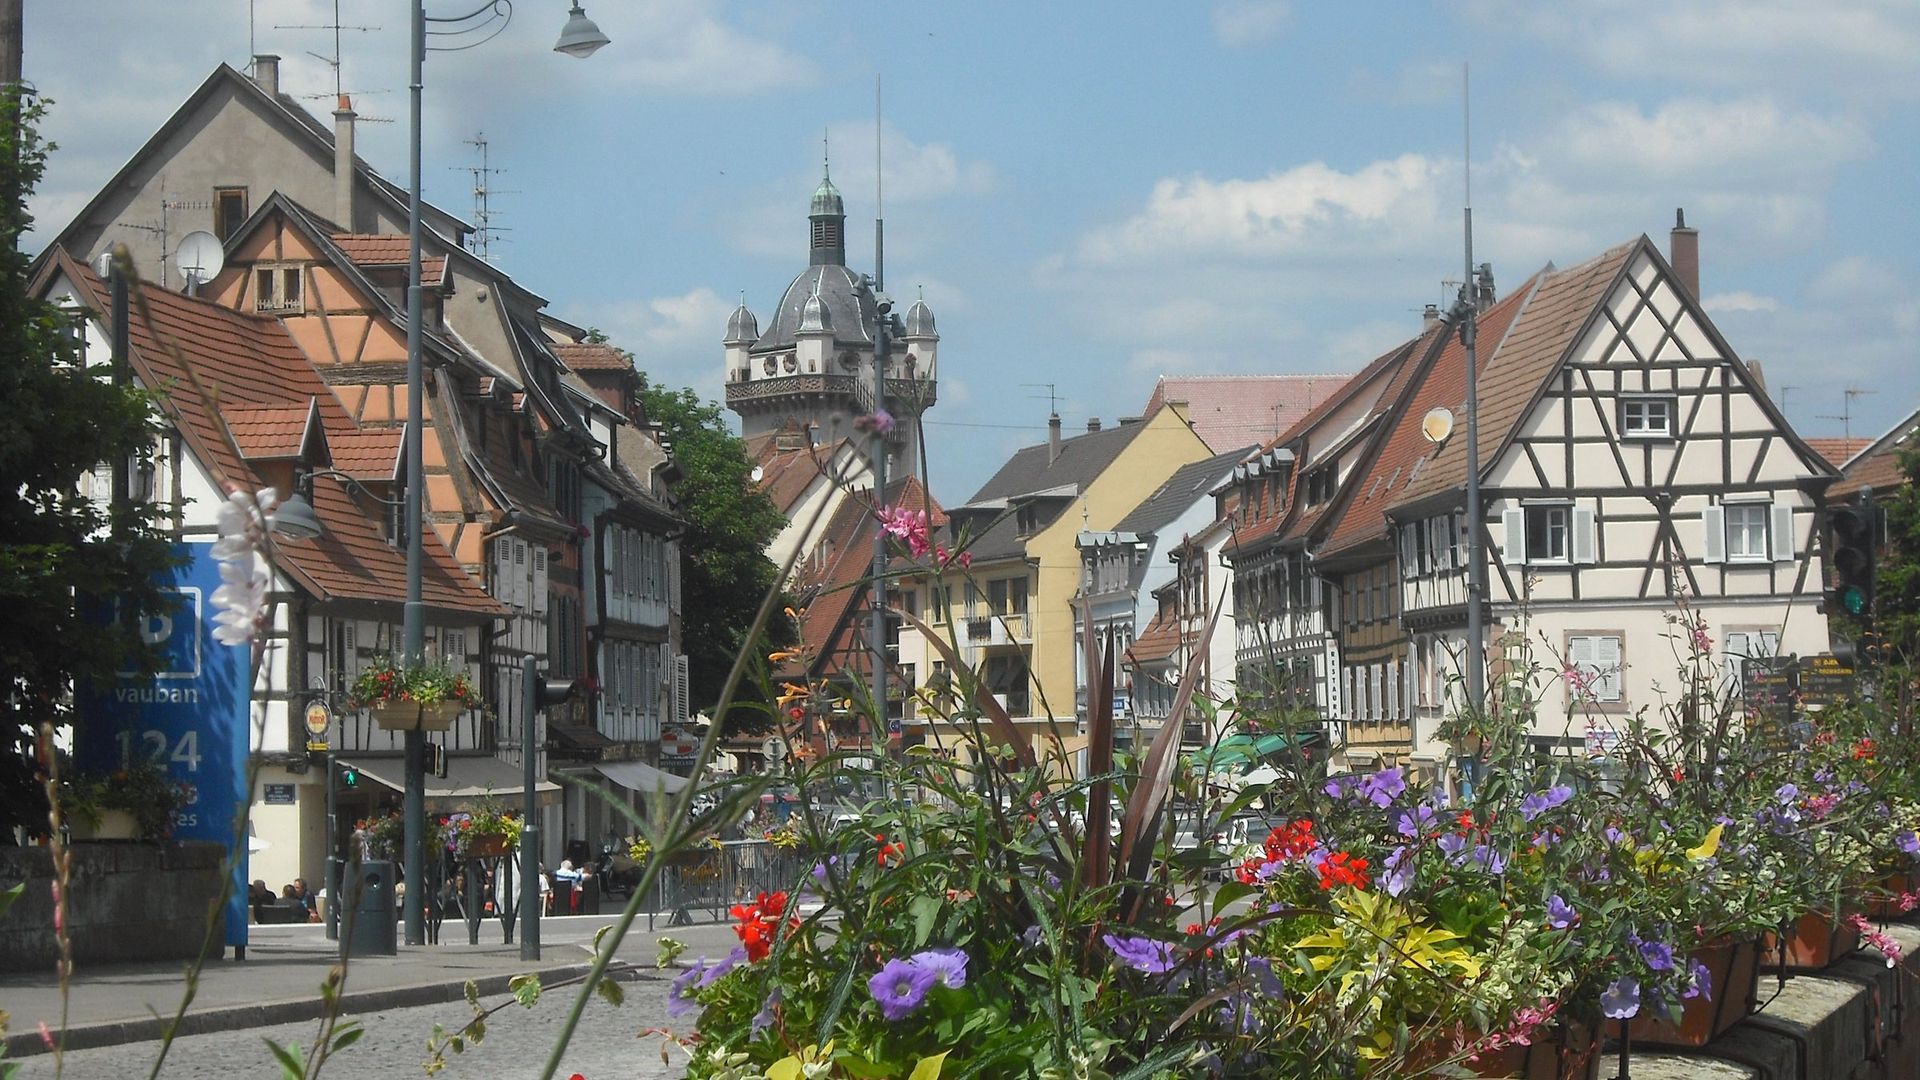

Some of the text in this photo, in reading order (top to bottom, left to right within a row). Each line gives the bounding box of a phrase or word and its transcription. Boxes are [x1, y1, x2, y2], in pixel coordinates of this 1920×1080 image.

[115, 680, 198, 703] vauban
[1330, 651, 1338, 736] RESTAURAT
[115, 730, 202, 772] 124
